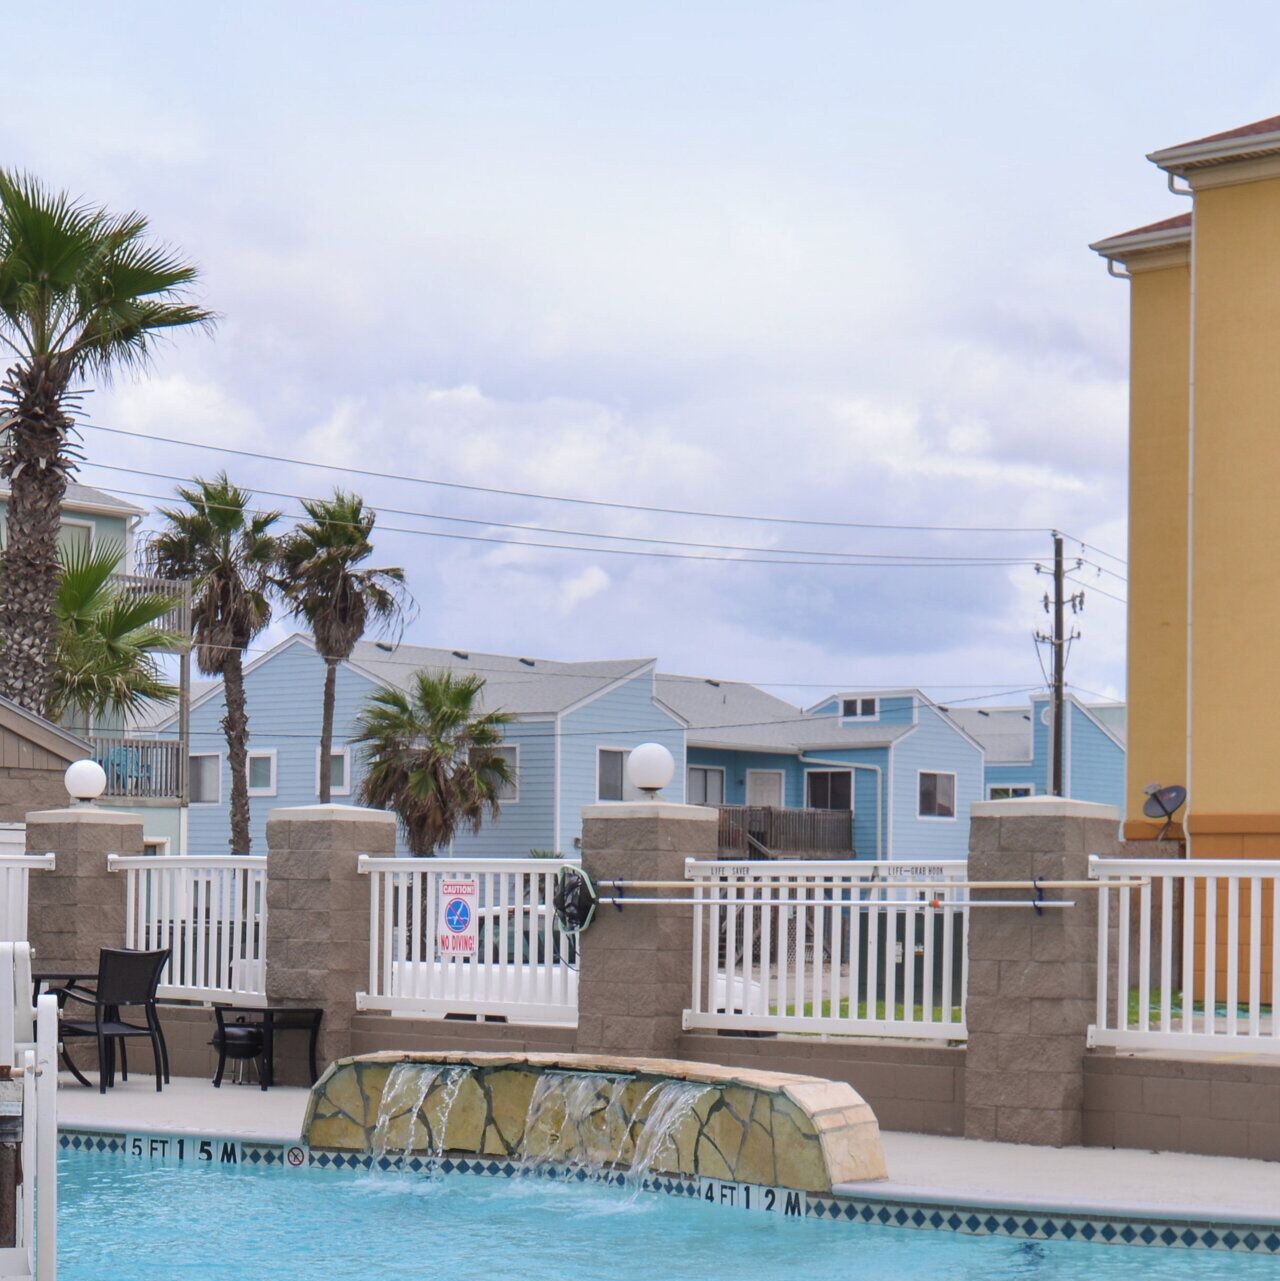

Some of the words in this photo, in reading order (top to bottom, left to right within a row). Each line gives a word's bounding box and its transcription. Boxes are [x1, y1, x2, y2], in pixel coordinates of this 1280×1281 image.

[711, 866, 725, 876] LIFE
[732, 866, 750, 876] SAVER
[443, 885, 474, 894] CAUTION!
[441, 935, 450, 950] NO
[452, 935, 475, 951] DIVING!
[132, 1138, 143, 1157] 5
[220, 1142, 237, 1164] M
[705, 1182, 715, 1203] 4
[784, 1191, 802, 1217] M
